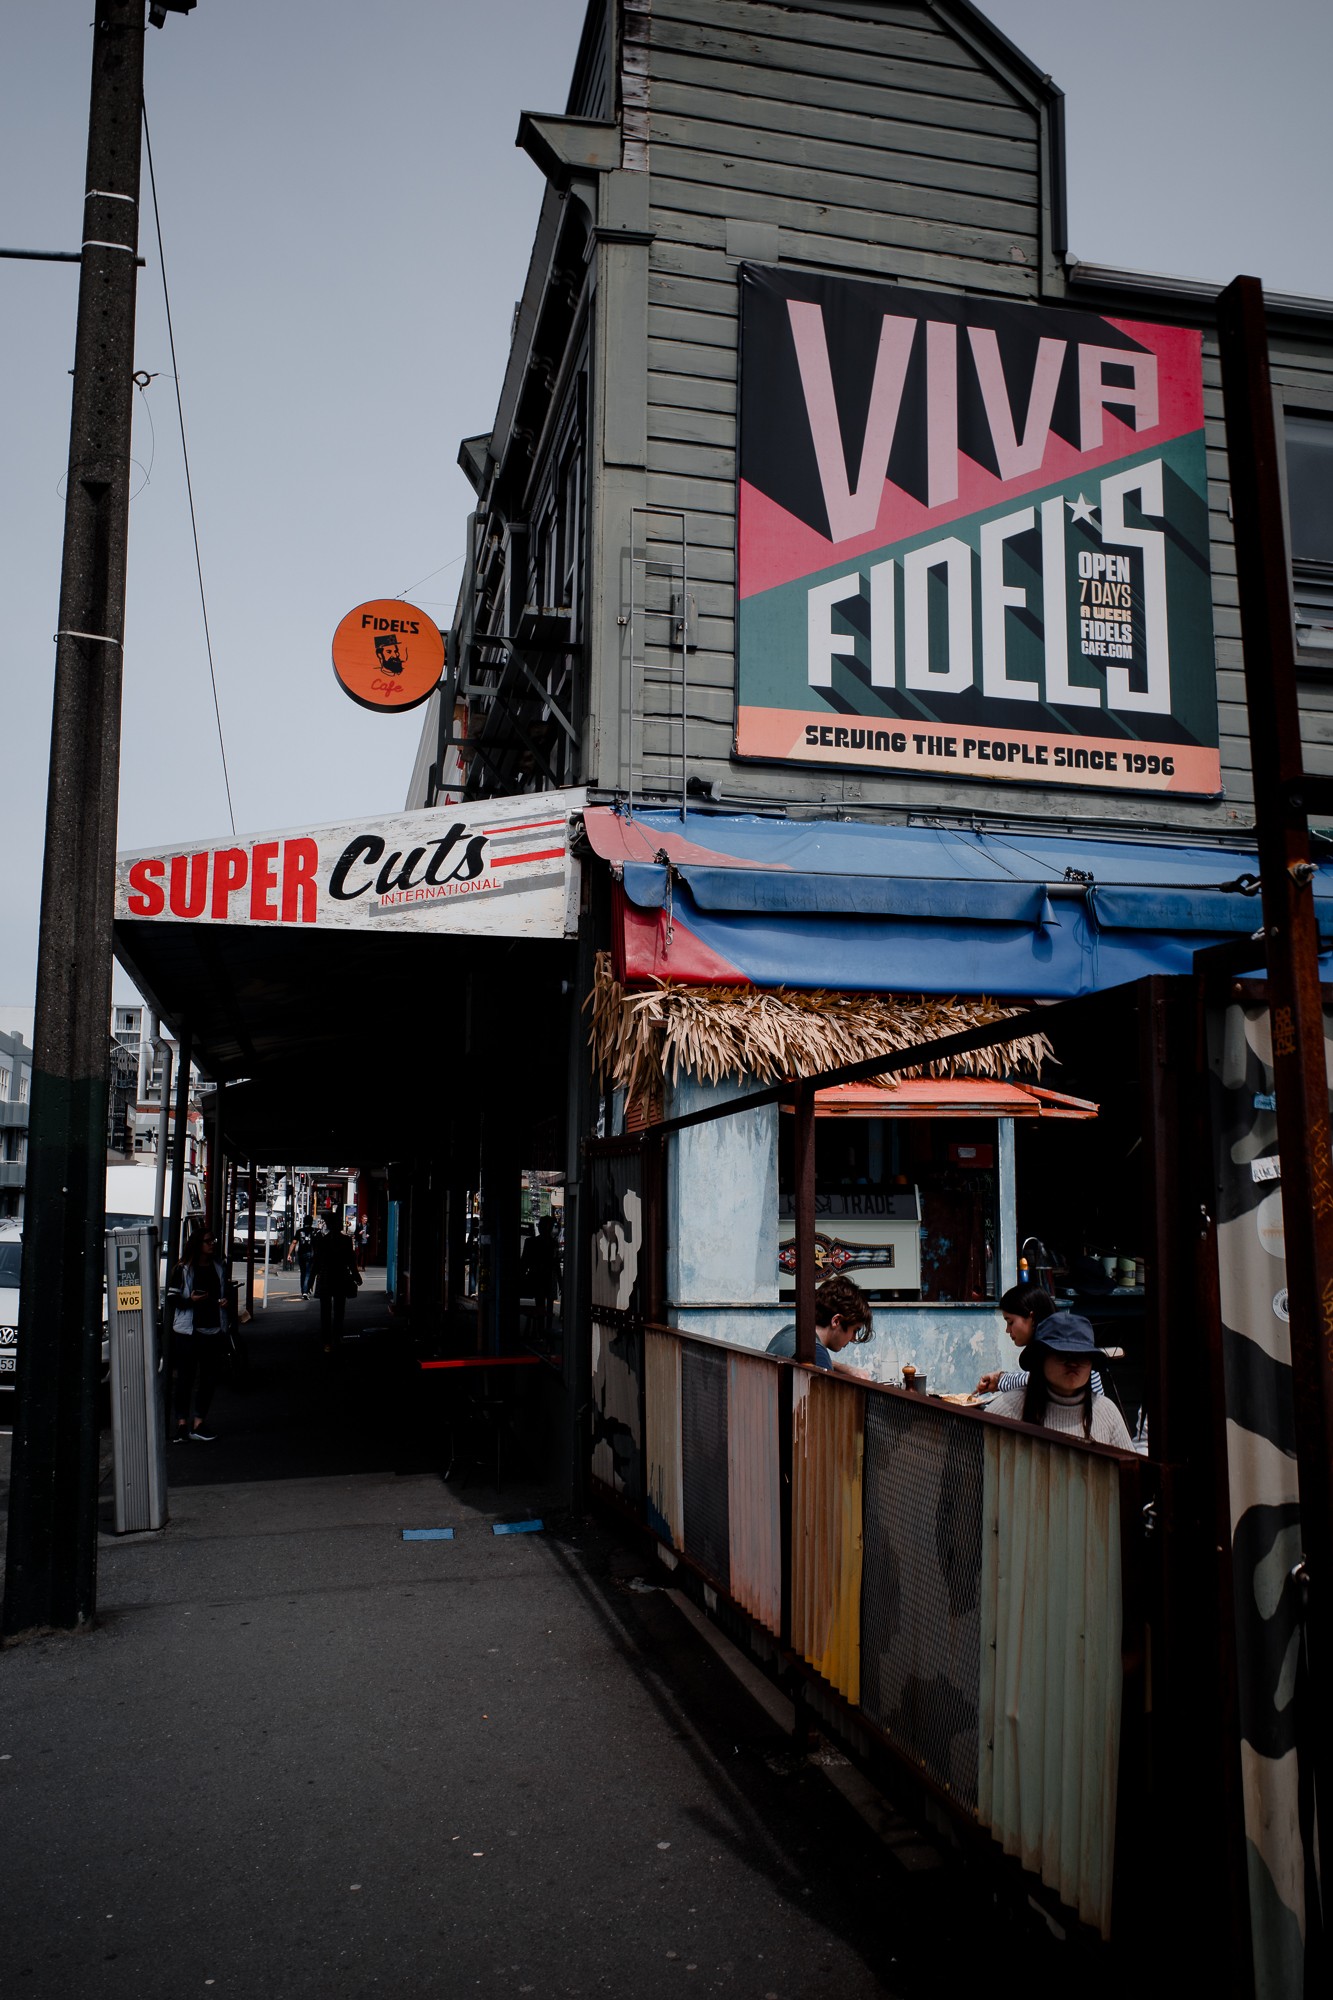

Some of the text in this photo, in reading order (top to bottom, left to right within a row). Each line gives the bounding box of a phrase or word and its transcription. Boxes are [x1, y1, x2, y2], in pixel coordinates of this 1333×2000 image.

[786, 298, 1160, 545] VIVA
[1078, 551, 1131, 583] OPEN
[1078, 579, 1131, 608] 7 DAYS
[361, 614, 420, 635] FIDEL'S
[1080, 605, 1132, 623] A WEEK
[1080, 619, 1133, 644] FIDELS
[1080, 640, 1133, 660] CAFE.COM
[370, 678, 404, 698] Cafe
[804, 724, 1176, 776] SERVING THE PEOPLE SINCE 1996
[127, 822, 492, 923] SUPER Cuts
[380, 878, 501, 906] INTERNATIONAL
[842, 1192, 896, 1215] TRADE
[119, 1247, 139, 1271] P
[118, 1279, 140, 1287] HERE
[121, 1272, 136, 1280] PAY
